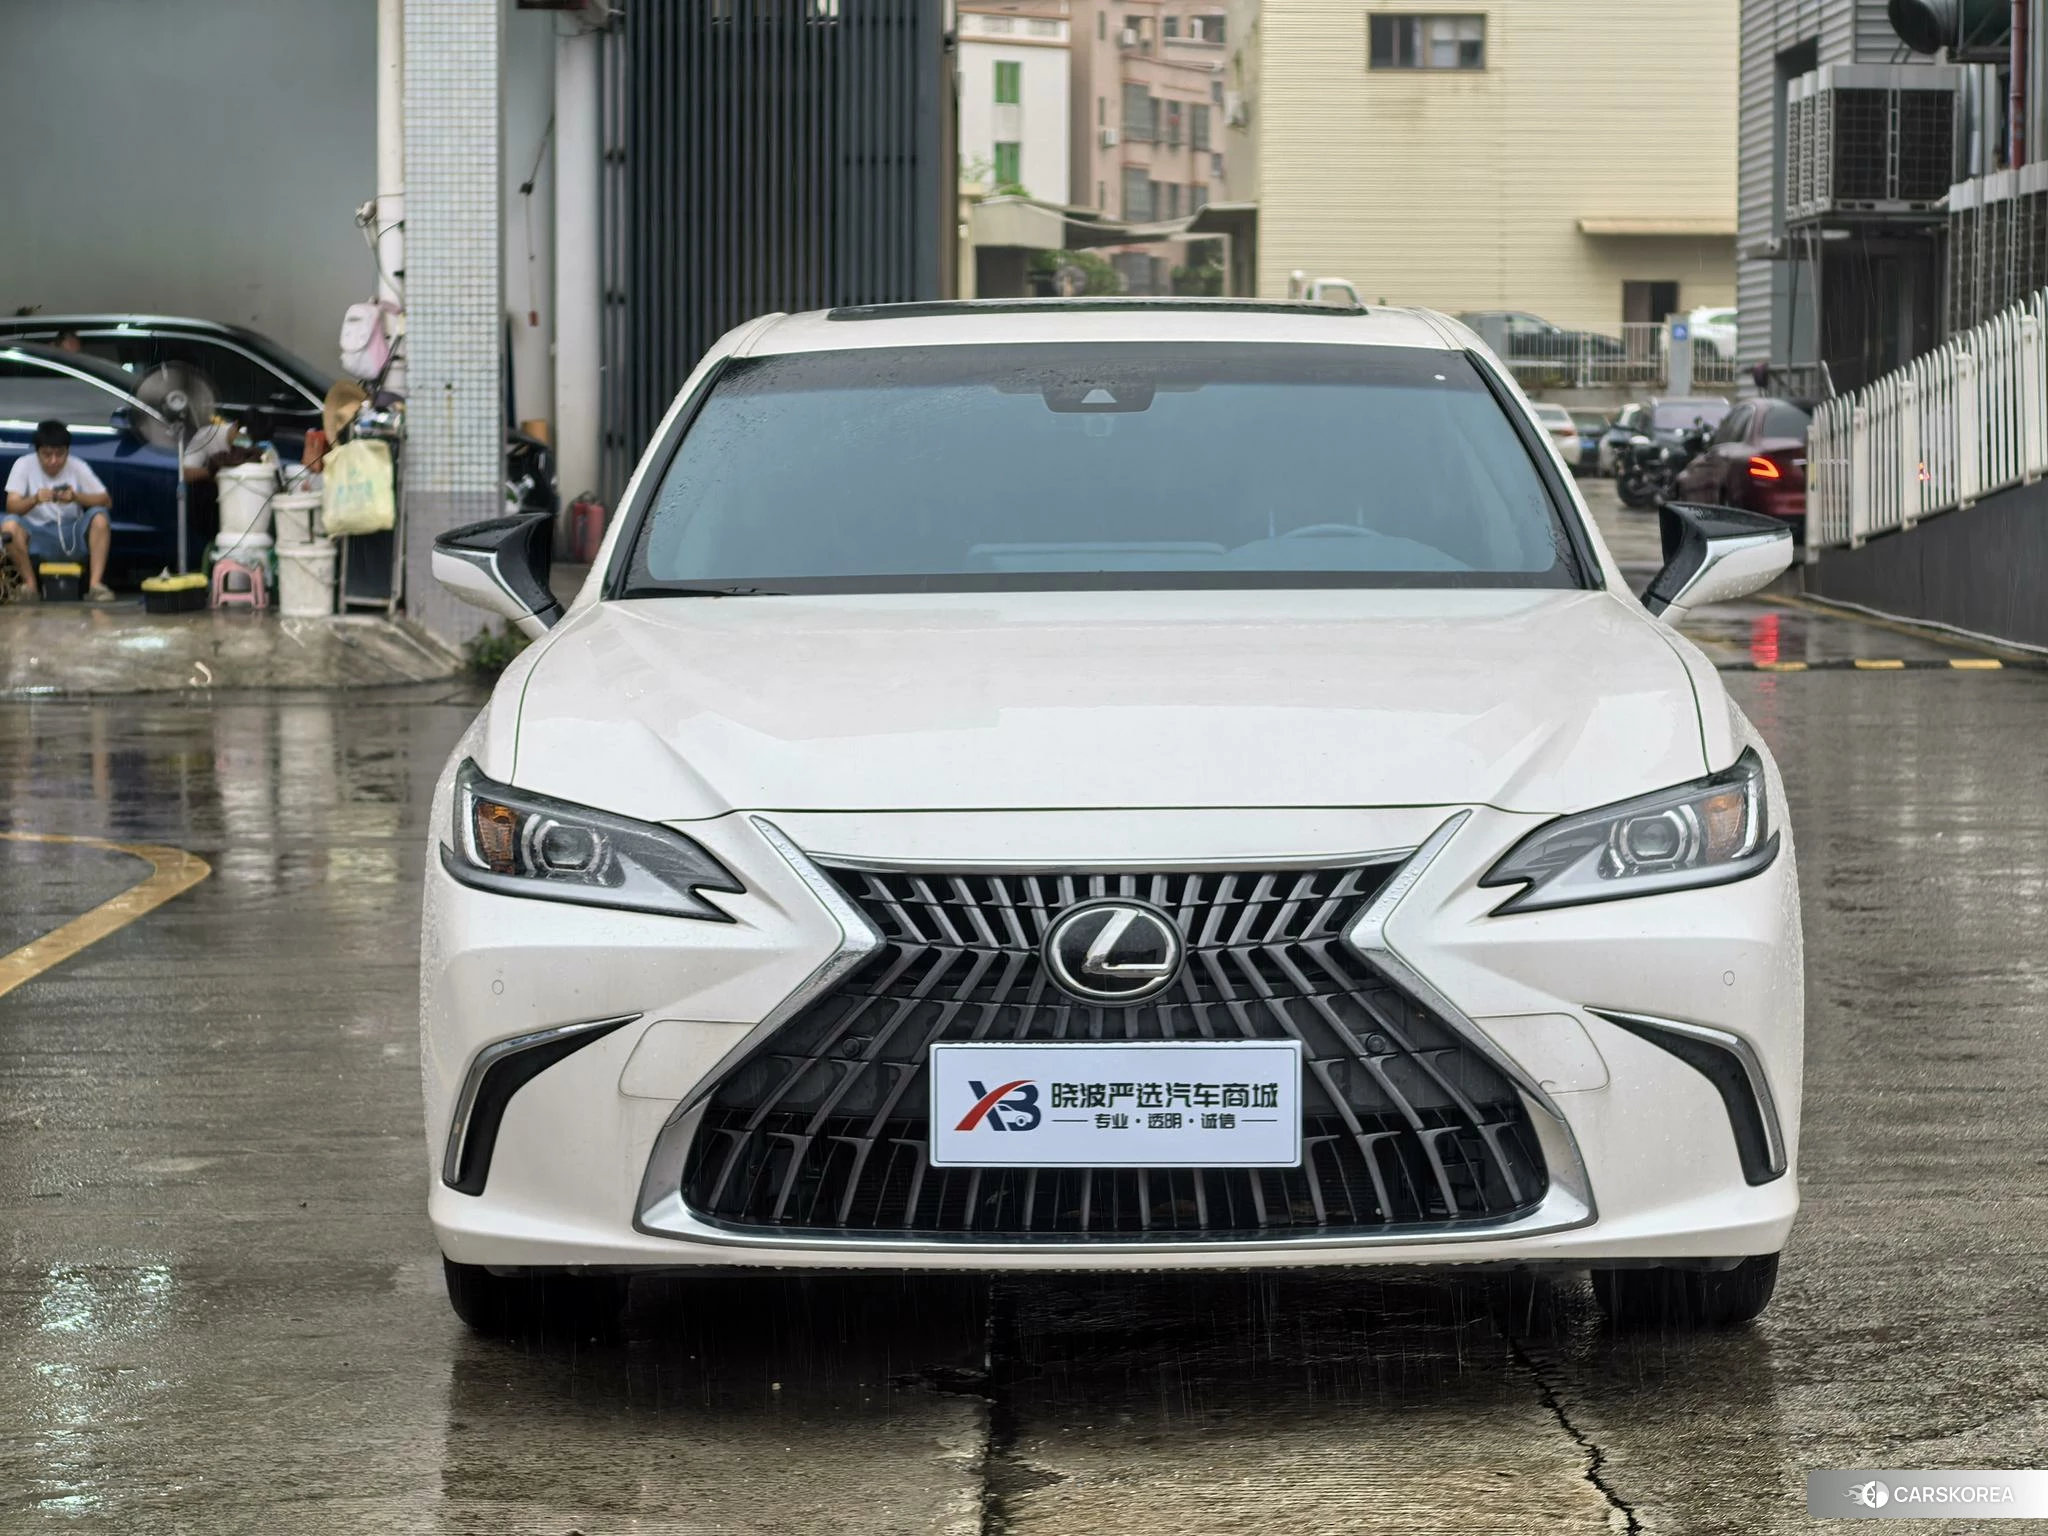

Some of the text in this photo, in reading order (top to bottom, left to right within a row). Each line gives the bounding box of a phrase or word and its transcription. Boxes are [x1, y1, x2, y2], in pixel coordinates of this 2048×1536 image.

[1051, 1082, 1279, 1109] 晓波严选汽车商城
